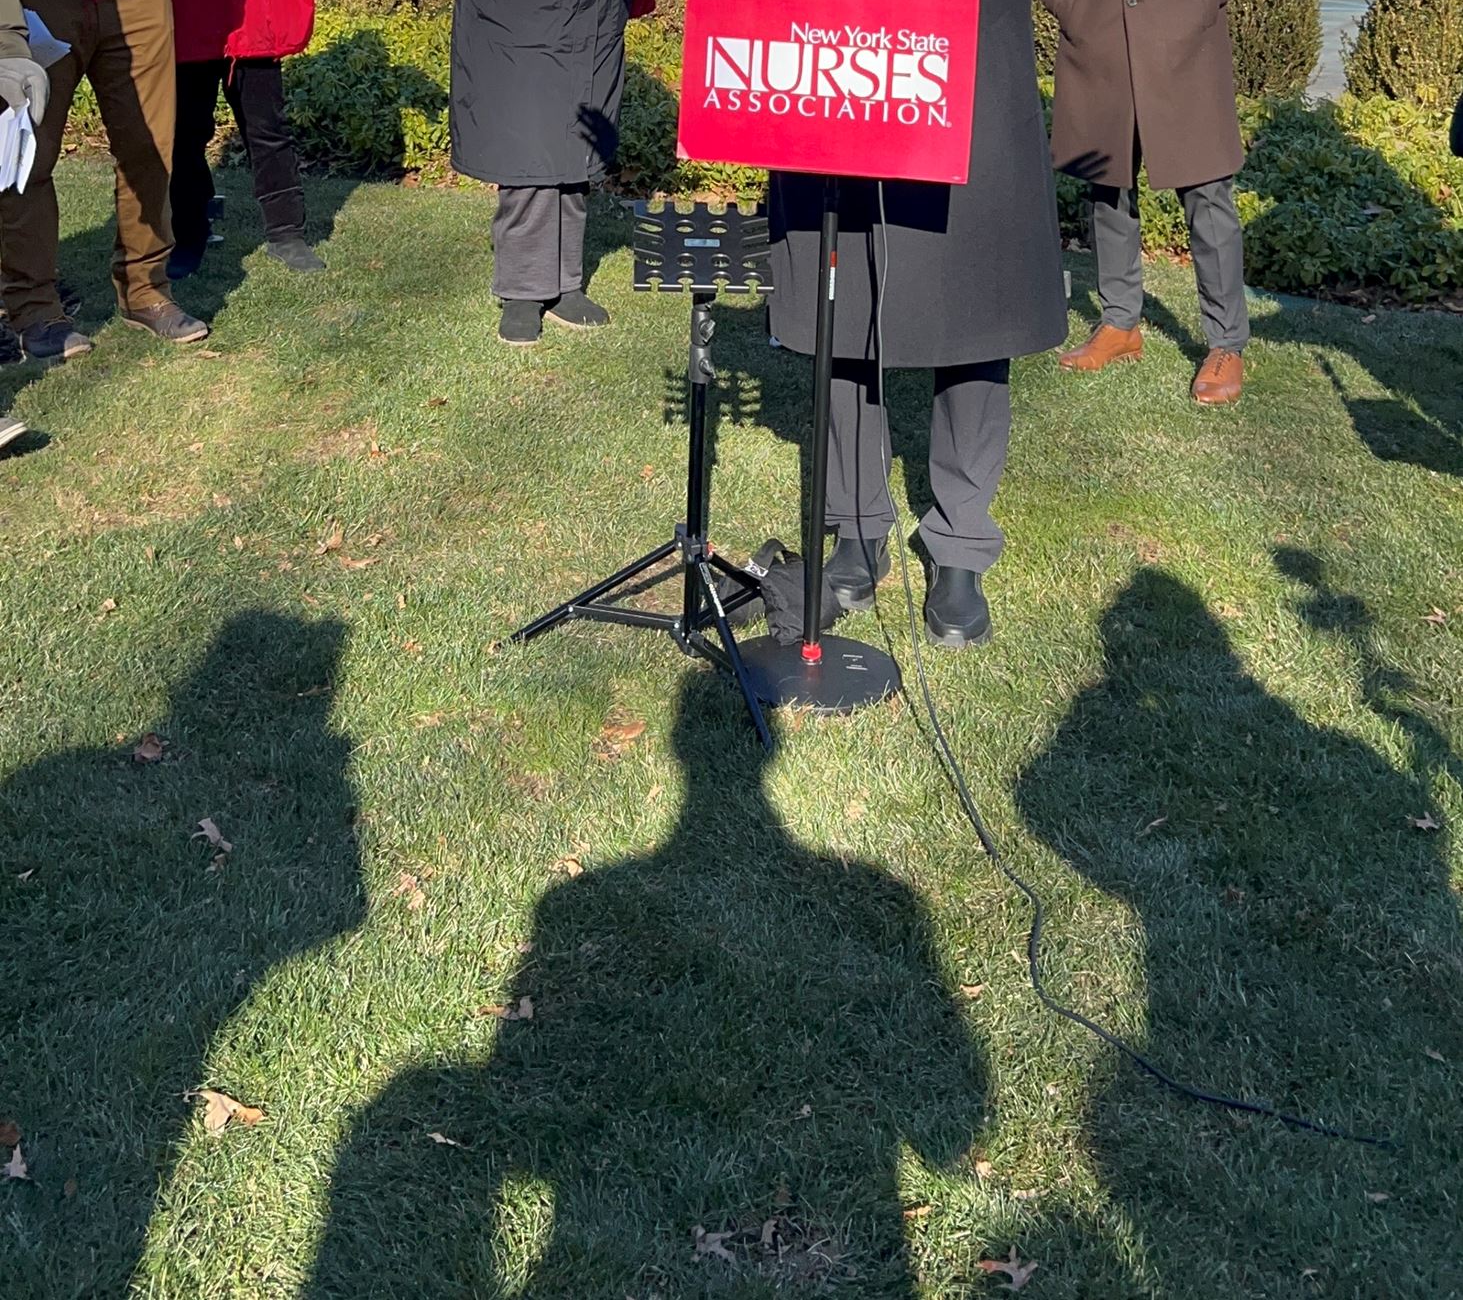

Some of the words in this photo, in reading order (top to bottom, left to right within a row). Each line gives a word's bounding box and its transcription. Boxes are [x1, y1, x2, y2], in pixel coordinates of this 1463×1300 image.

[790, 21, 841, 46] New
[844, 24, 893, 49] York
[896, 29, 950, 53] State
[704, 35, 949, 106] NURSES
[704, 88, 949, 127] ASSOCIATION
